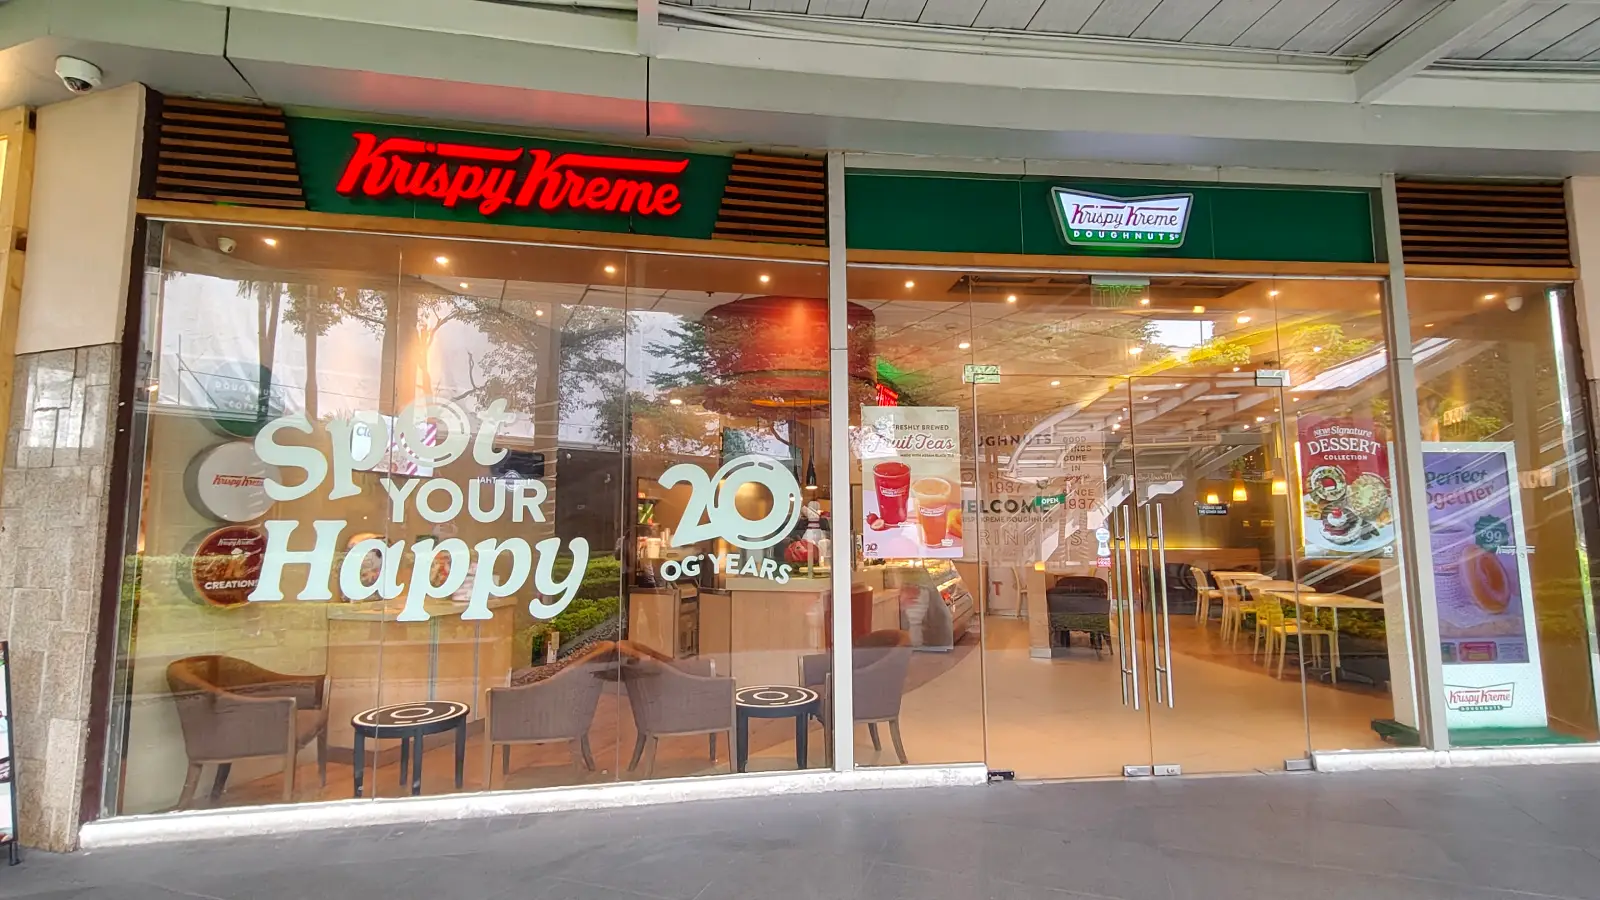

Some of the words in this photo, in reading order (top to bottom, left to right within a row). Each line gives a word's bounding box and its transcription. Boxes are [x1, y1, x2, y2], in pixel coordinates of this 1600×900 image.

[336, 132, 523, 216] Krispy
[514, 149, 690, 216] Kreme
[1071, 203, 1126, 229] Krispy
[1126, 206, 1180, 226] Kreme
[915, 433, 954, 449] Teas
[1331, 425, 1372, 437] Signature
[1307, 437, 1381, 455] DESSERT
[380, 478, 548, 523] YOUR
[658, 454, 802, 549] 20
[248, 519, 590, 621] Happy
[709, 553, 793, 584] YEARS
[1449, 690, 1480, 705] Krispy
[1480, 689, 1511, 702] Kreme
